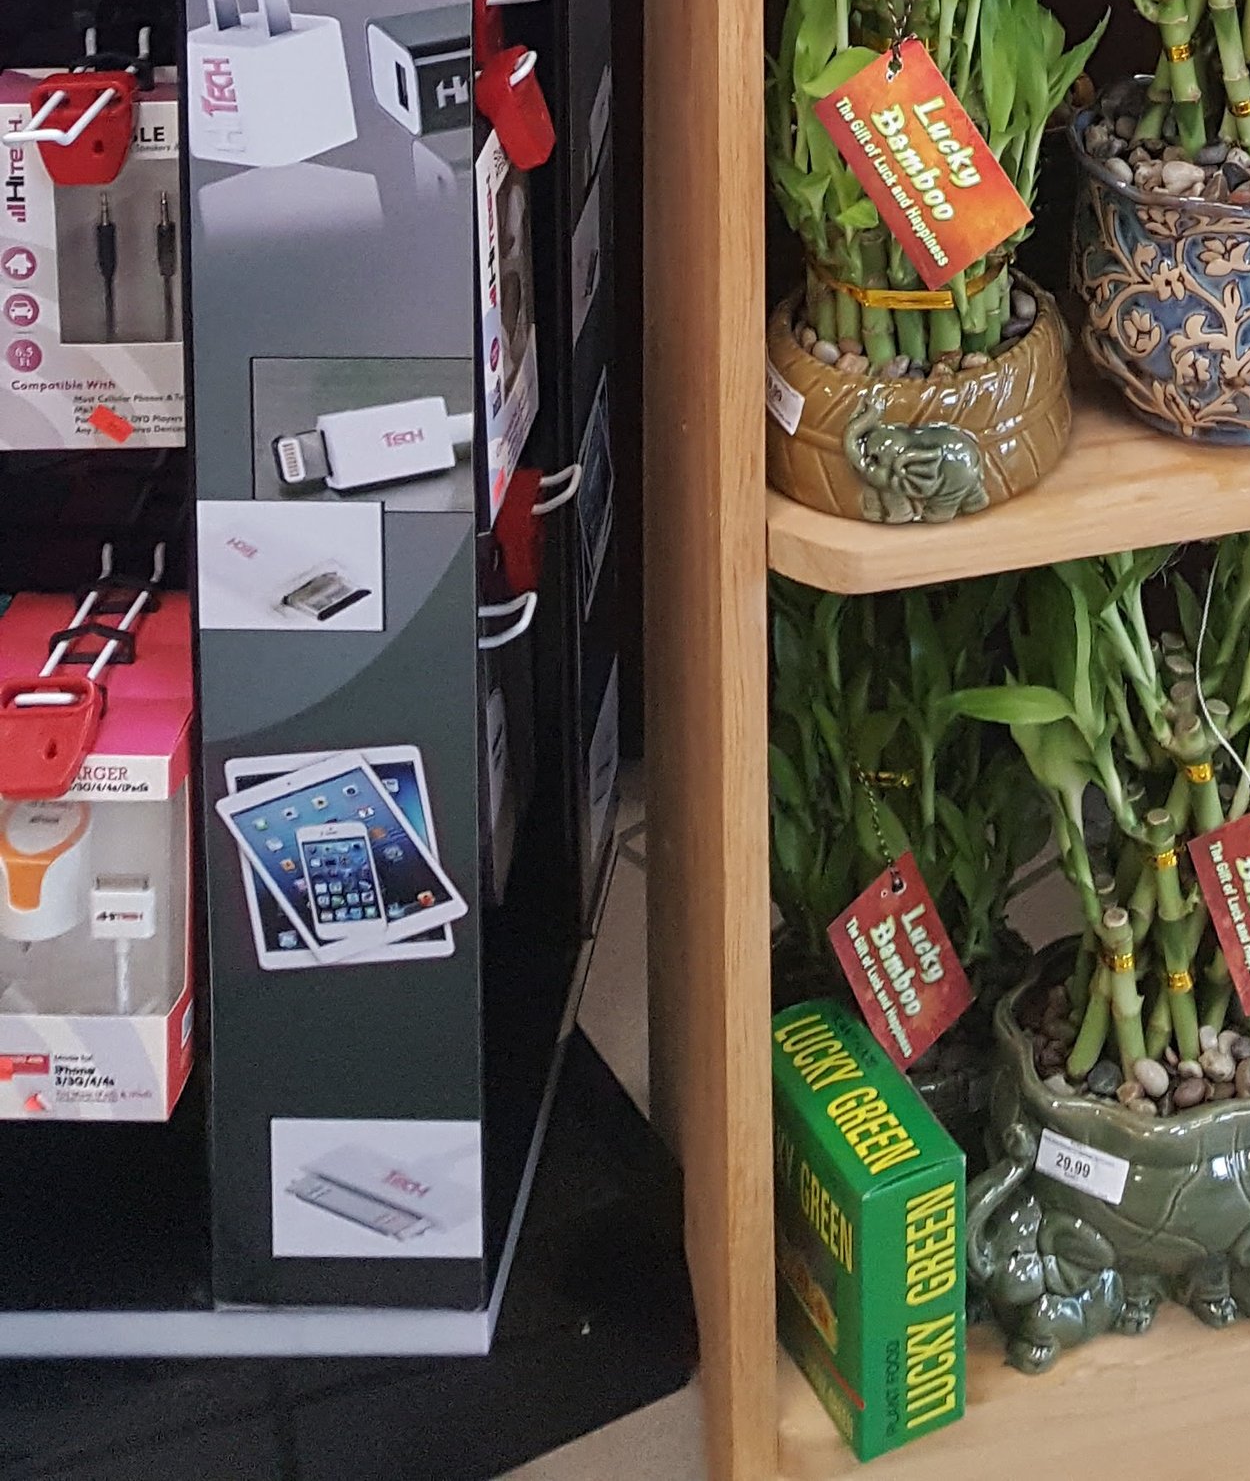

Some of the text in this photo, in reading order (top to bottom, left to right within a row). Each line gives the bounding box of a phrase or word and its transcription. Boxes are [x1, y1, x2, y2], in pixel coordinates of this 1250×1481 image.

[913, 96, 981, 188] Lucky
[871, 104, 954, 221] Bamboo
[835, 96, 949, 267] The Gift of Luck and Happiness
[14, 346, 34, 357] 6.5
[11, 379, 116, 393] Compatible With
[75, 426, 92, 435] Any
[153, 414, 183, 423] Players
[1209, 840, 1223, 862] The
[1216, 861, 1232, 885] Gift
[1223, 880, 1238, 896] of
[1227, 895, 1245, 924] Luck
[846, 916, 860, 939] The
[901, 903, 944, 983] Lucky
[867, 965, 885, 993] Luck
[869, 914, 921, 1016] Bamboo
[877, 989, 894, 1011] and
[885, 1004, 912, 1058] Happiness
[774, 1014, 864, 1092] LUCKY
[826, 1085, 920, 1176] GREEN
[800, 1162, 854, 1274] GREEN
[906, 1180, 957, 1430] LUCKY GREEN
